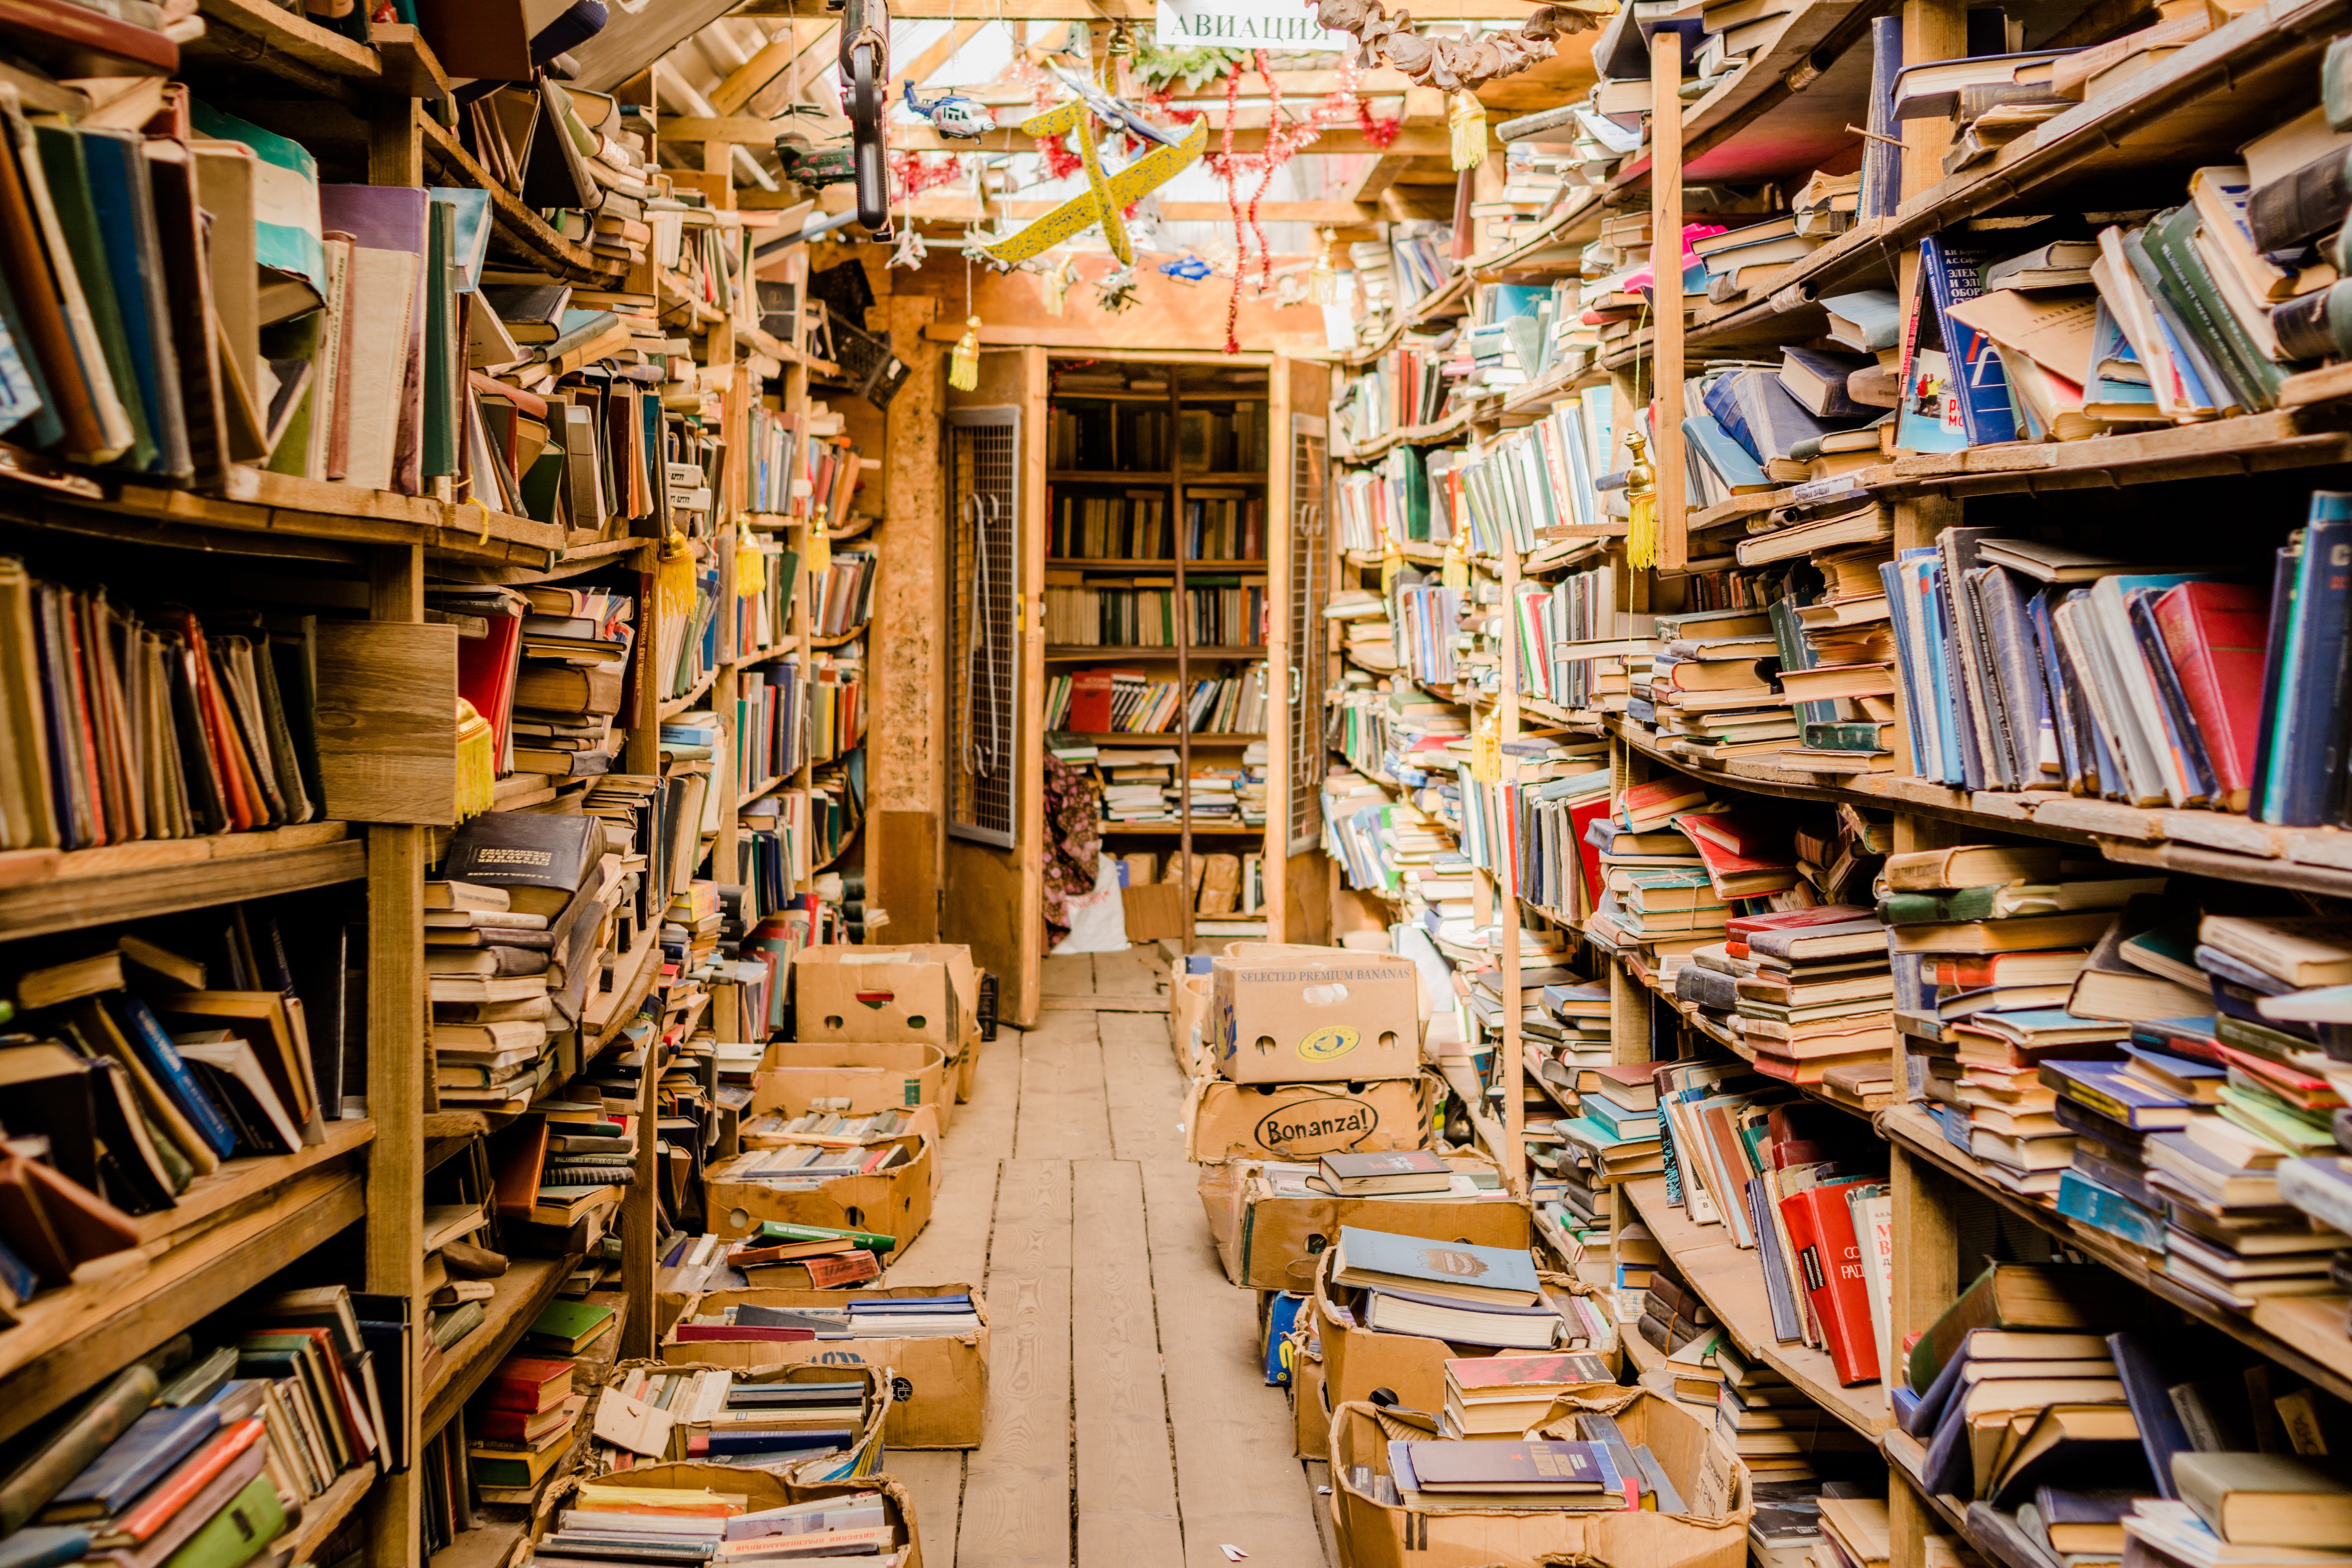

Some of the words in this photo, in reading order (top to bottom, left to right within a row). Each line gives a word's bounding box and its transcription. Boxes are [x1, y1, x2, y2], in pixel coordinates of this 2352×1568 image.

[1171, 13, 1330, 43] АВИАЦИЯ
[1947, 269, 1978, 278] ЭЛЕК
[1949, 279, 1959, 288] И
[1908, 316, 1919, 336] море
[1907, 336, 1915, 346] на
[1902, 347, 1913, 373] работа
[670, 495, 690, 504] РТ-АРТУР
[639, 613, 649, 645] УКРАЇНИ
[638, 647, 646, 660] ГАЗ
[635, 663, 645, 689] НАФТА
[1241, 972, 1296, 982] SELECTED
[1299, 970, 1354, 981] PREMIUM
[1357, 968, 1410, 980] BANANAS
[1307, 1029, 1348, 1044] ИМПЕРИАЛ
[1312, 1044, 1350, 1056] IMPERIAL
[1267, 1107, 1368, 1145] Bonanza!
[1877, 1225, 1891, 1240] М
[1880, 1241, 1891, 1255] В
[1841, 1265, 1866, 1279] РАД
